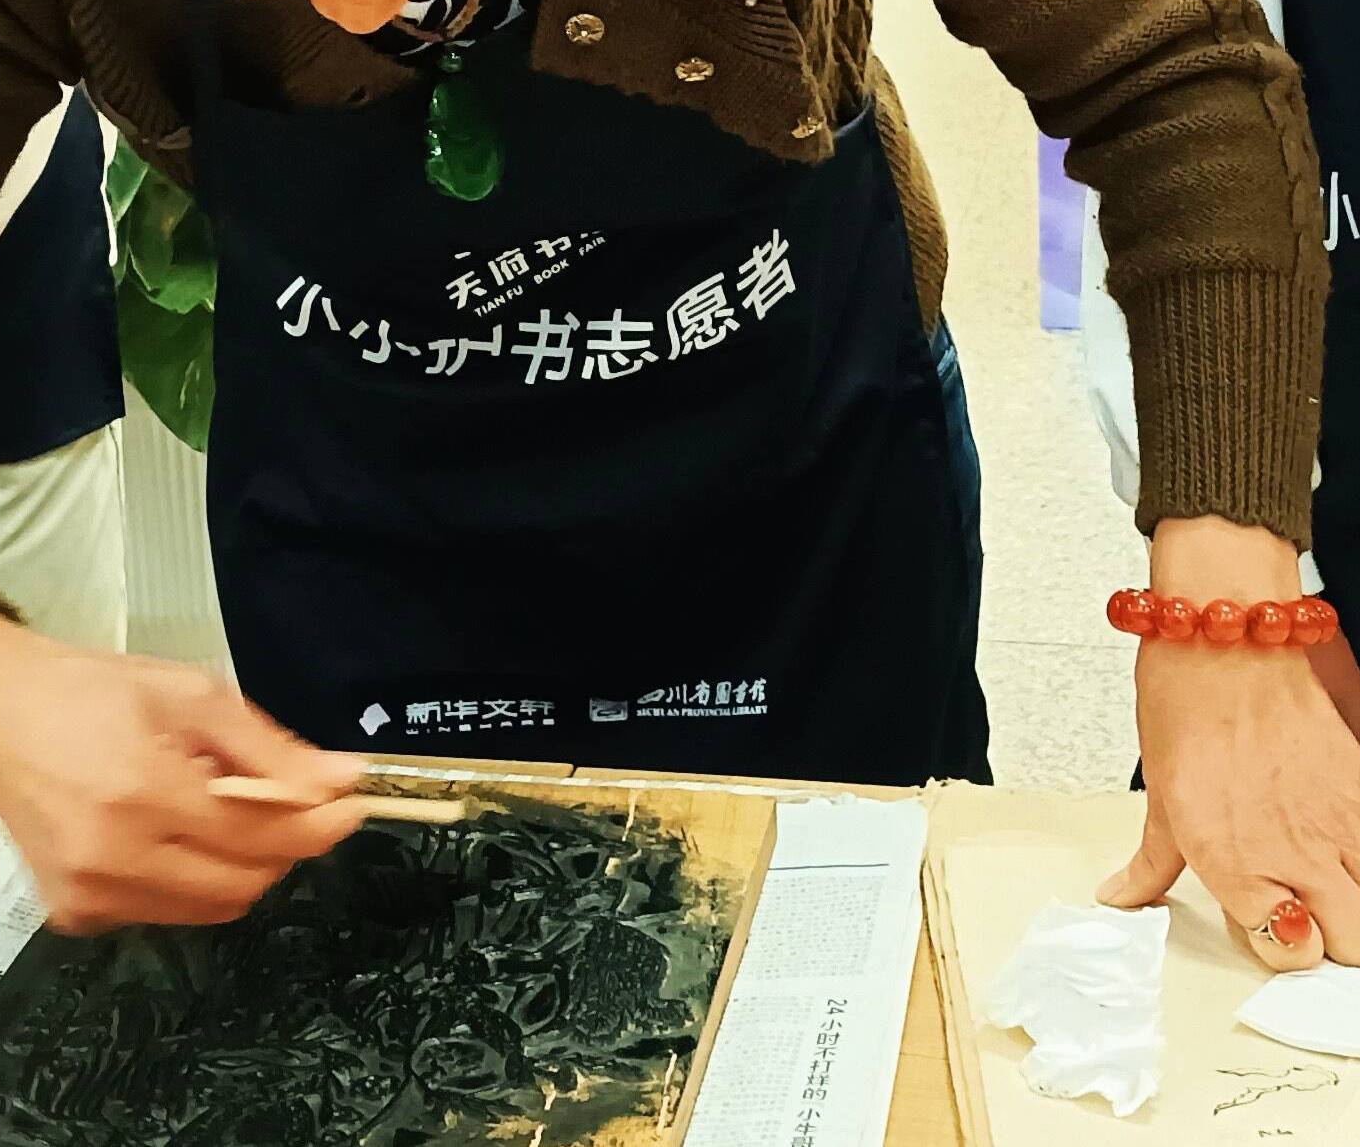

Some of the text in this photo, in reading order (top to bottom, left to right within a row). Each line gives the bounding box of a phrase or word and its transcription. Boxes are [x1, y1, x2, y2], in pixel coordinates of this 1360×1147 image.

[474, 236, 607, 318] TIAN FU BOOK FAIR
[405, 699, 555, 725] 新华文轩
